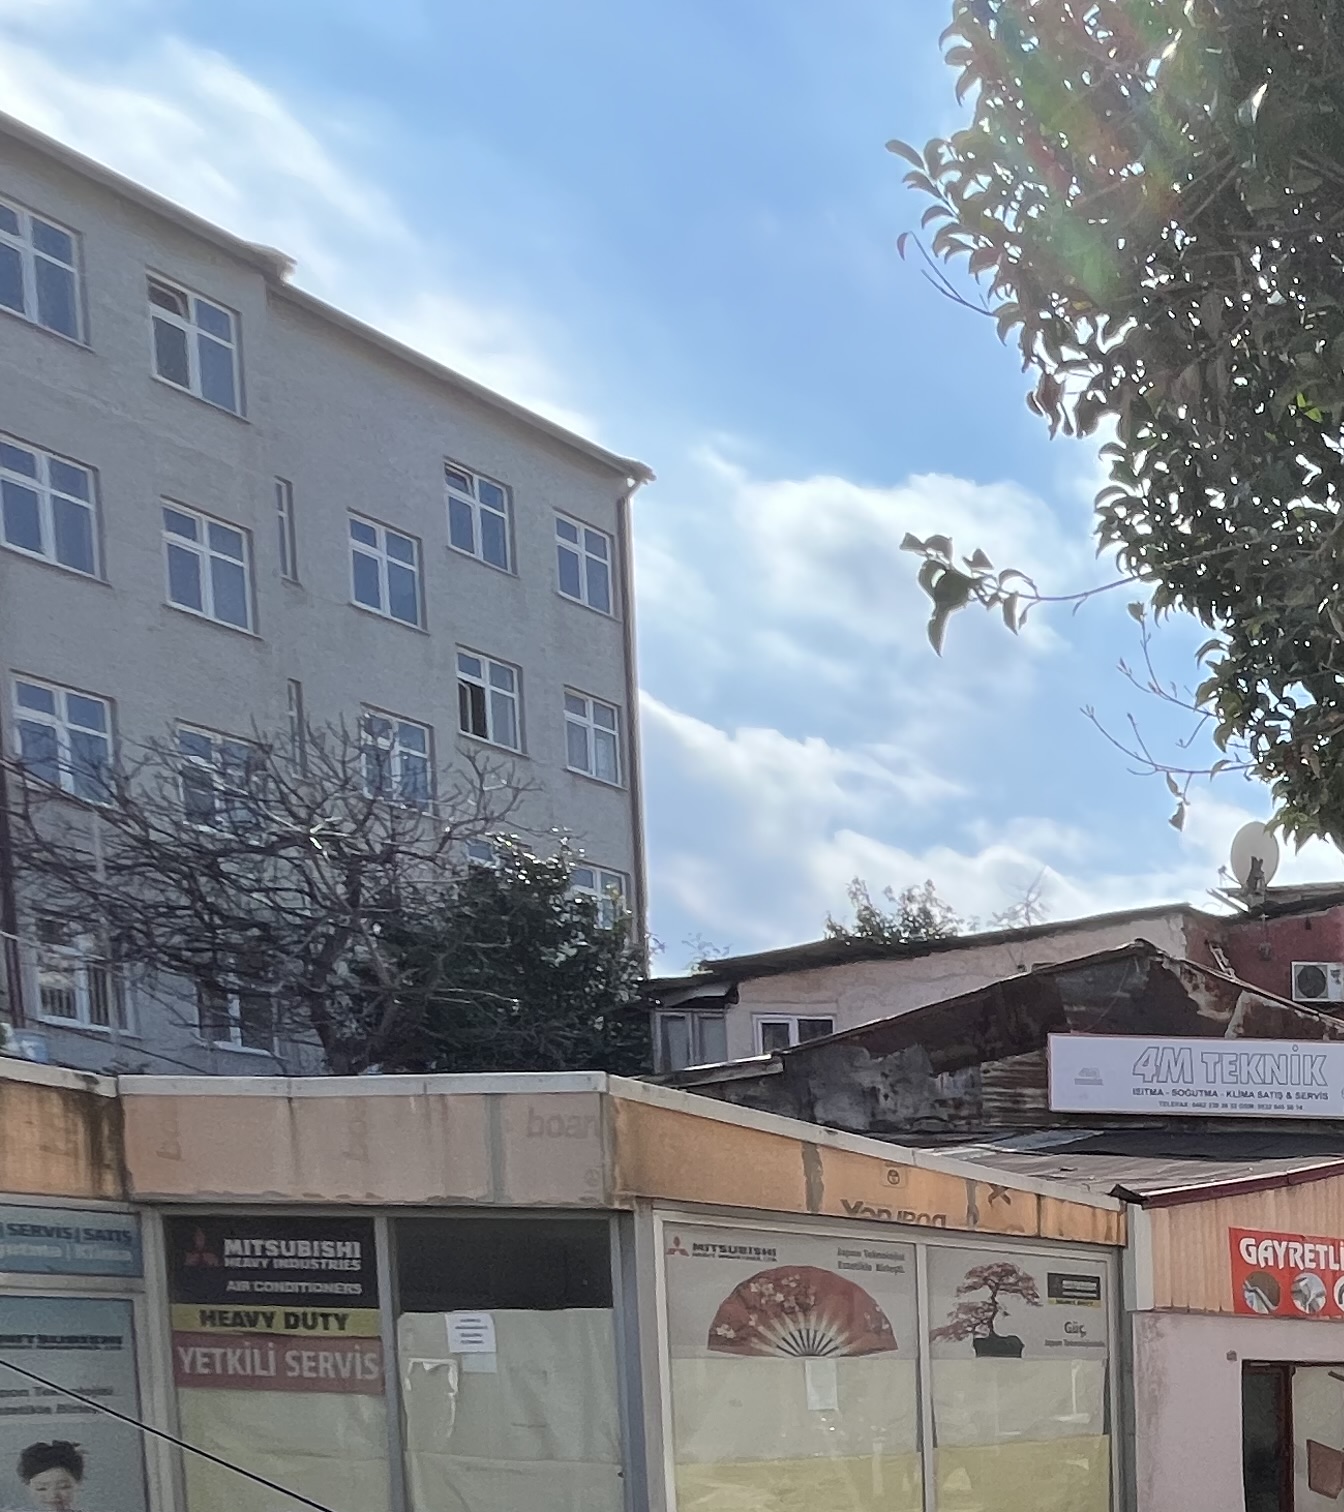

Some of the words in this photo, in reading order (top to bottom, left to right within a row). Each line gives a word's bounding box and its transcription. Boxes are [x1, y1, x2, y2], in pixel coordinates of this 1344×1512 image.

[1132, 1046, 1194, 1084] 4M
[1201, 1044, 1328, 1086] TEKNİK
[223, 1238, 362, 1258] MITSUBISHI
[692, 1242, 777, 1257] MITSUBISHI
[223, 1257, 270, 1269] HEAVY
[272, 1258, 362, 1271] INDUSTRIES
[226, 1280, 250, 1292] AIR
[253, 1281, 362, 1295] CONDITIONERS
[200, 1309, 276, 1329] HEAVY
[284, 1311, 350, 1331] DUTY
[178, 1341, 277, 1377] YETKİLİ
[284, 1343, 380, 1380] SERVİS
